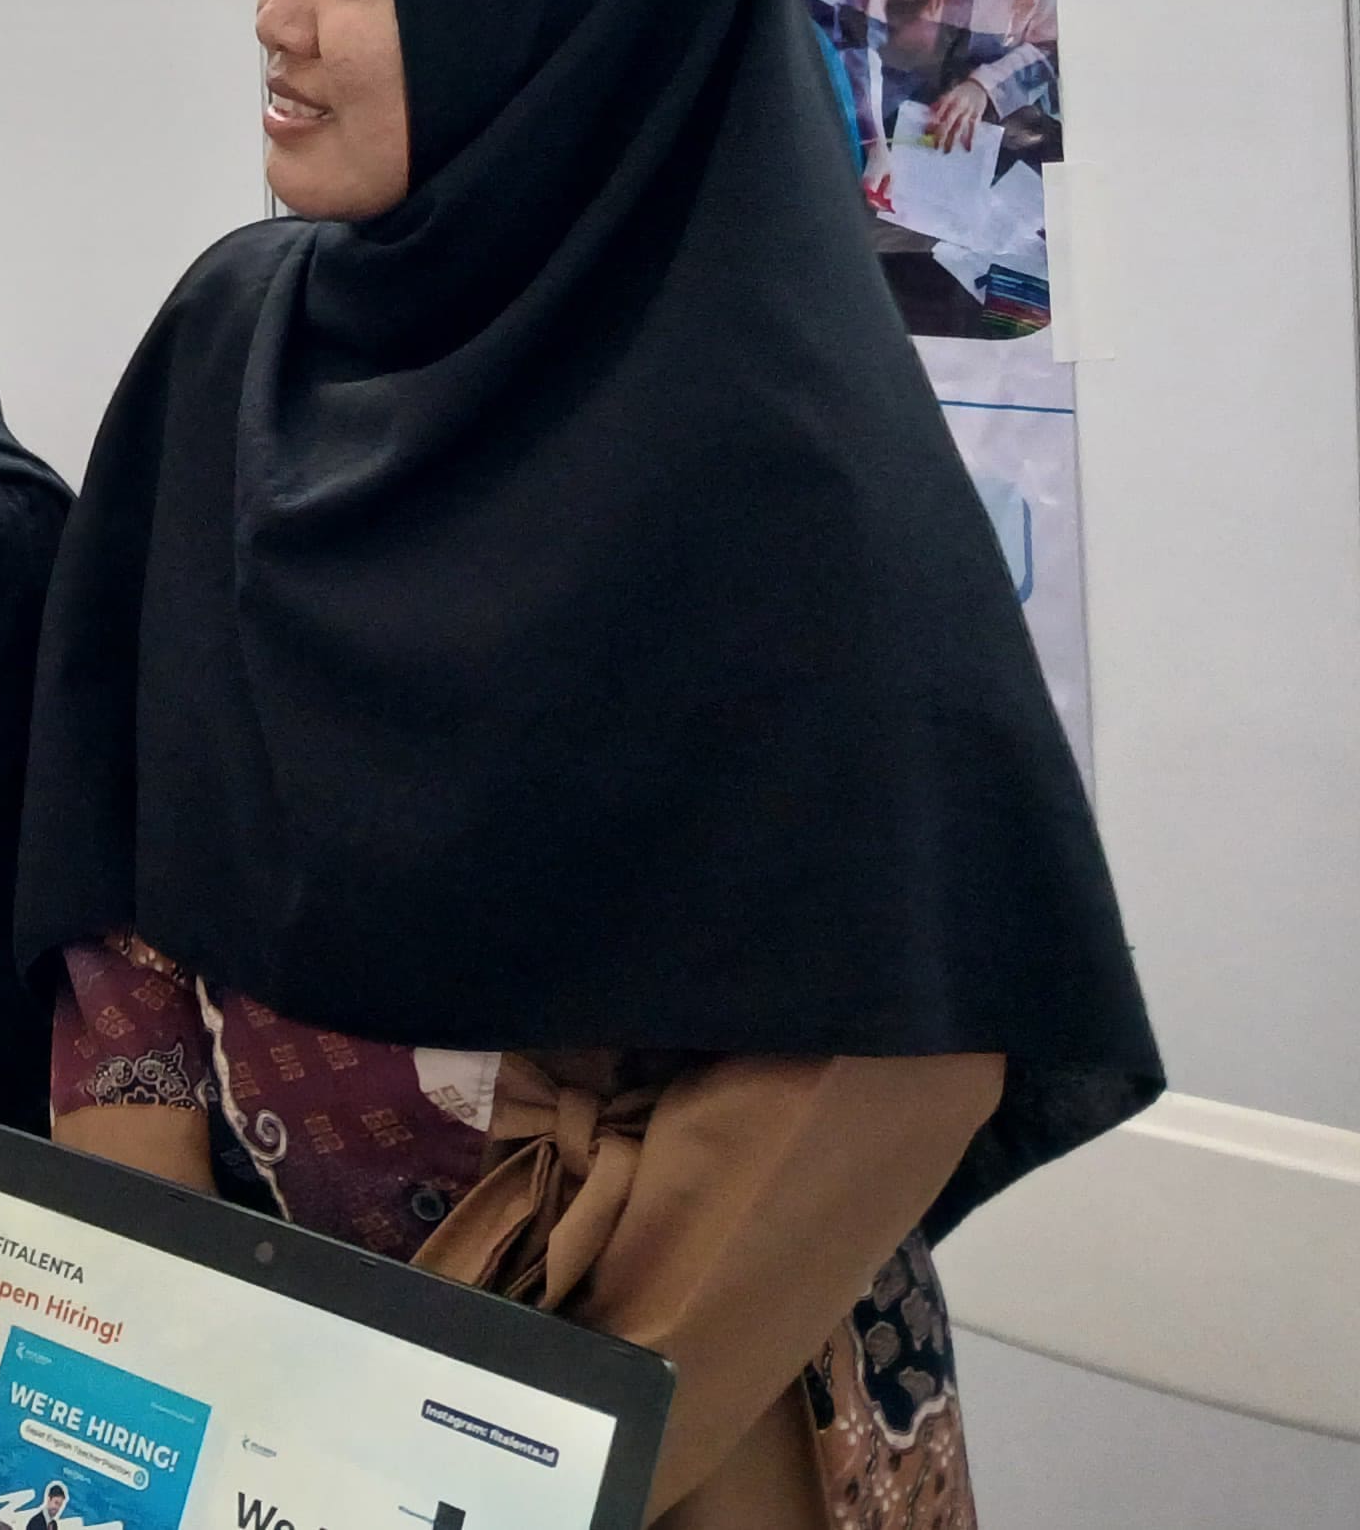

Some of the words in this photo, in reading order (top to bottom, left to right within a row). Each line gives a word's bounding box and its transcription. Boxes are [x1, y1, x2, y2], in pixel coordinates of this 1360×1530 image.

[45, 1295, 125, 1345] Hiring!
[10, 1381, 84, 1432] WE'RE
[86, 1415, 180, 1473] HIRING!
[425, 1403, 489, 1437] Instagram:
